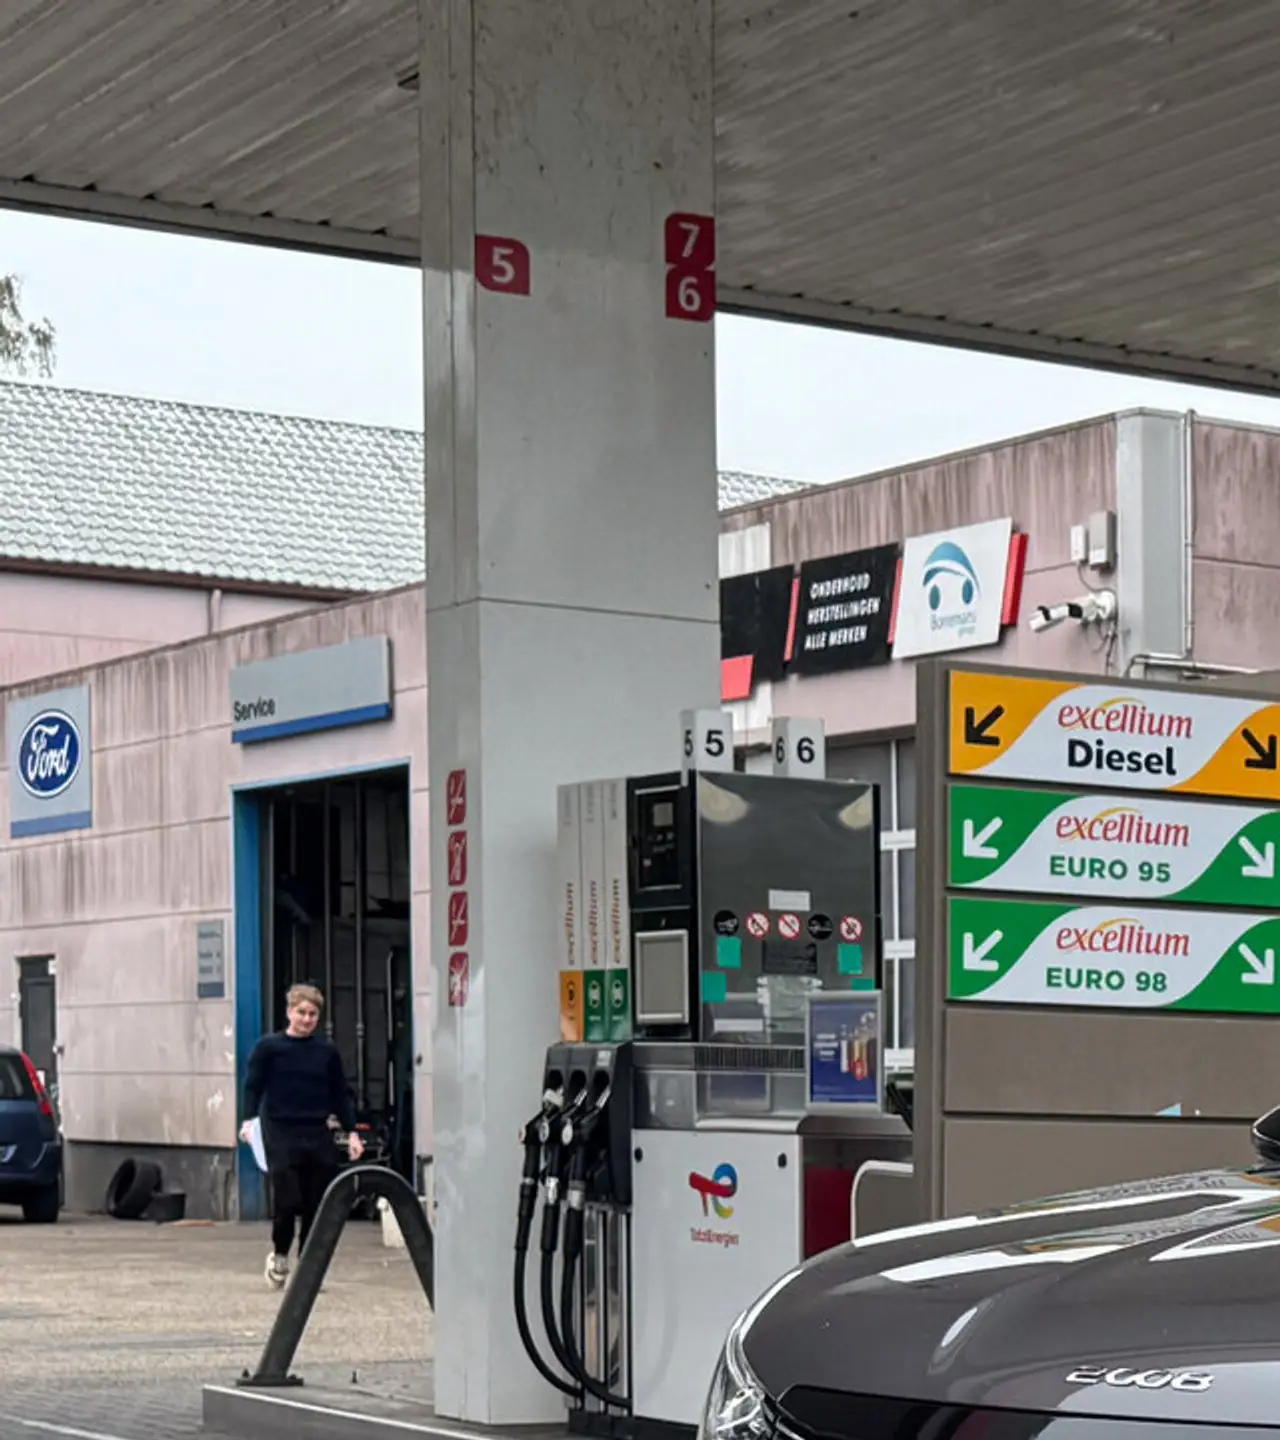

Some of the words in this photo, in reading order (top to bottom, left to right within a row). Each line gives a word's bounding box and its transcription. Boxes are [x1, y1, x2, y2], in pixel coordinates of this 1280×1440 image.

[677, 221, 701, 258] 7
[491, 246, 516, 284] 5
[677, 276, 702, 312] 6
[810, 571, 872, 600] ONDERHOUD
[807, 597, 881, 625] HERSTELLINGEN
[804, 630, 828, 651] ALLE
[828, 624, 868, 647] MERKEN
[233, 696, 276, 723] Service
[1057, 703, 1193, 739] excellium
[27, 723, 71, 782] Ford
[683, 730, 694, 758] 5
[704, 730, 725, 757] 5
[774, 736, 786, 763] 6
[796, 737, 816, 764] 6
[1067, 738, 1177, 776] Diesel
[1055, 814, 1190, 847] excellium
[1049, 855, 1128, 880] EURO
[1138, 861, 1171, 883] 95
[1056, 924, 1190, 956] excellium
[1046, 967, 1126, 991] EURO
[1135, 971, 1168, 992] 98
[1065, 1365, 1215, 1391] 2008
